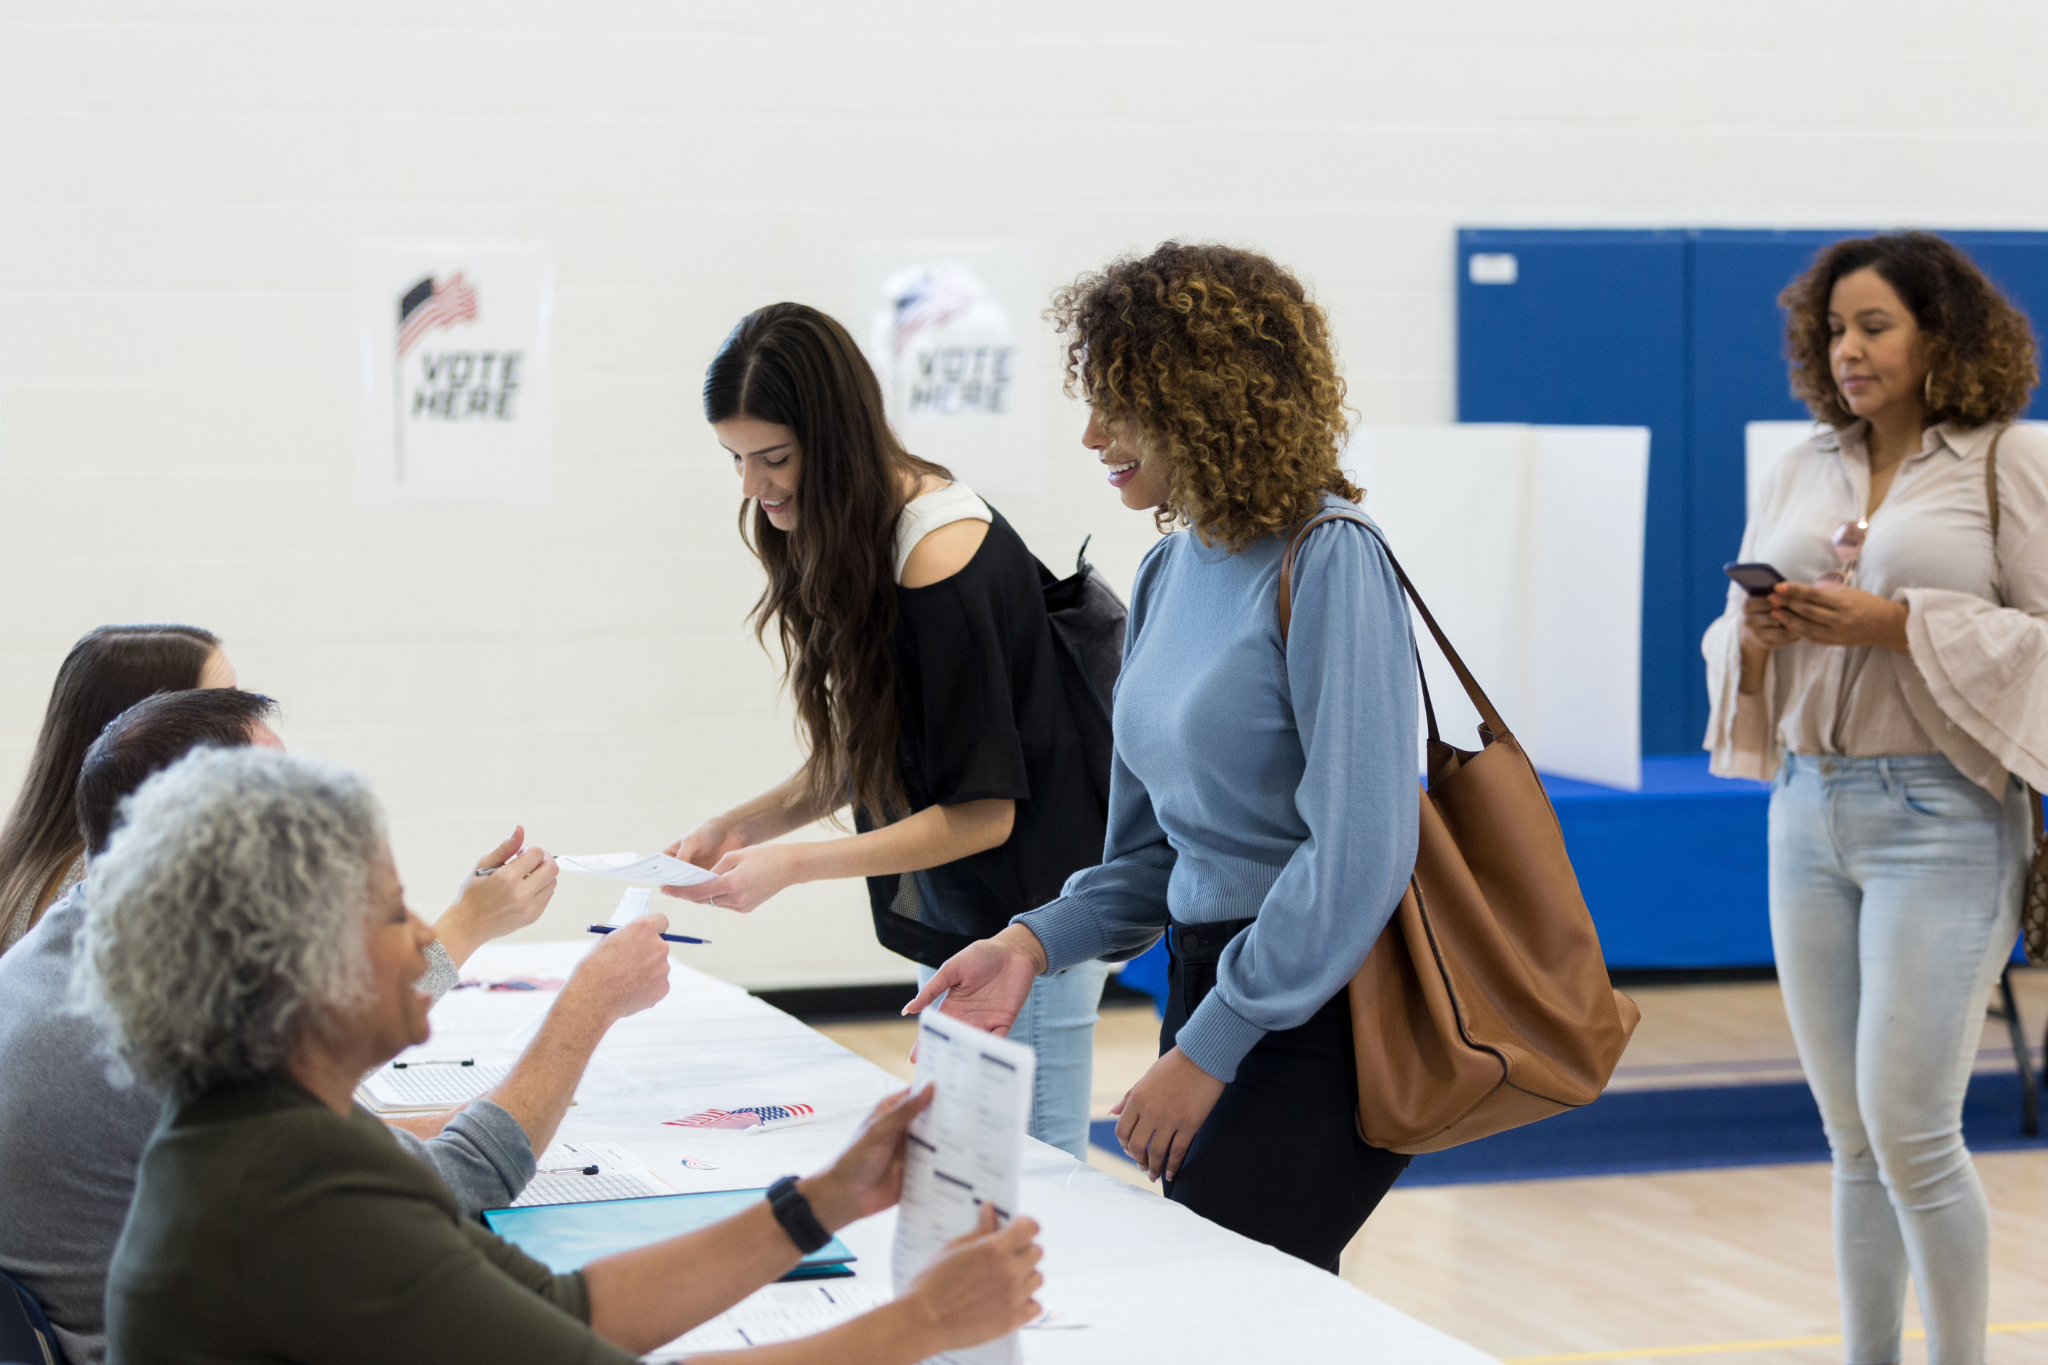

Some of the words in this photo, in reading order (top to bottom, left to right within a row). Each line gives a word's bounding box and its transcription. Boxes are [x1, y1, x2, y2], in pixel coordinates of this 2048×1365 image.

[421, 349, 525, 389] VOTE
[917, 346, 1016, 384] VOTE
[412, 385, 517, 421] HERE
